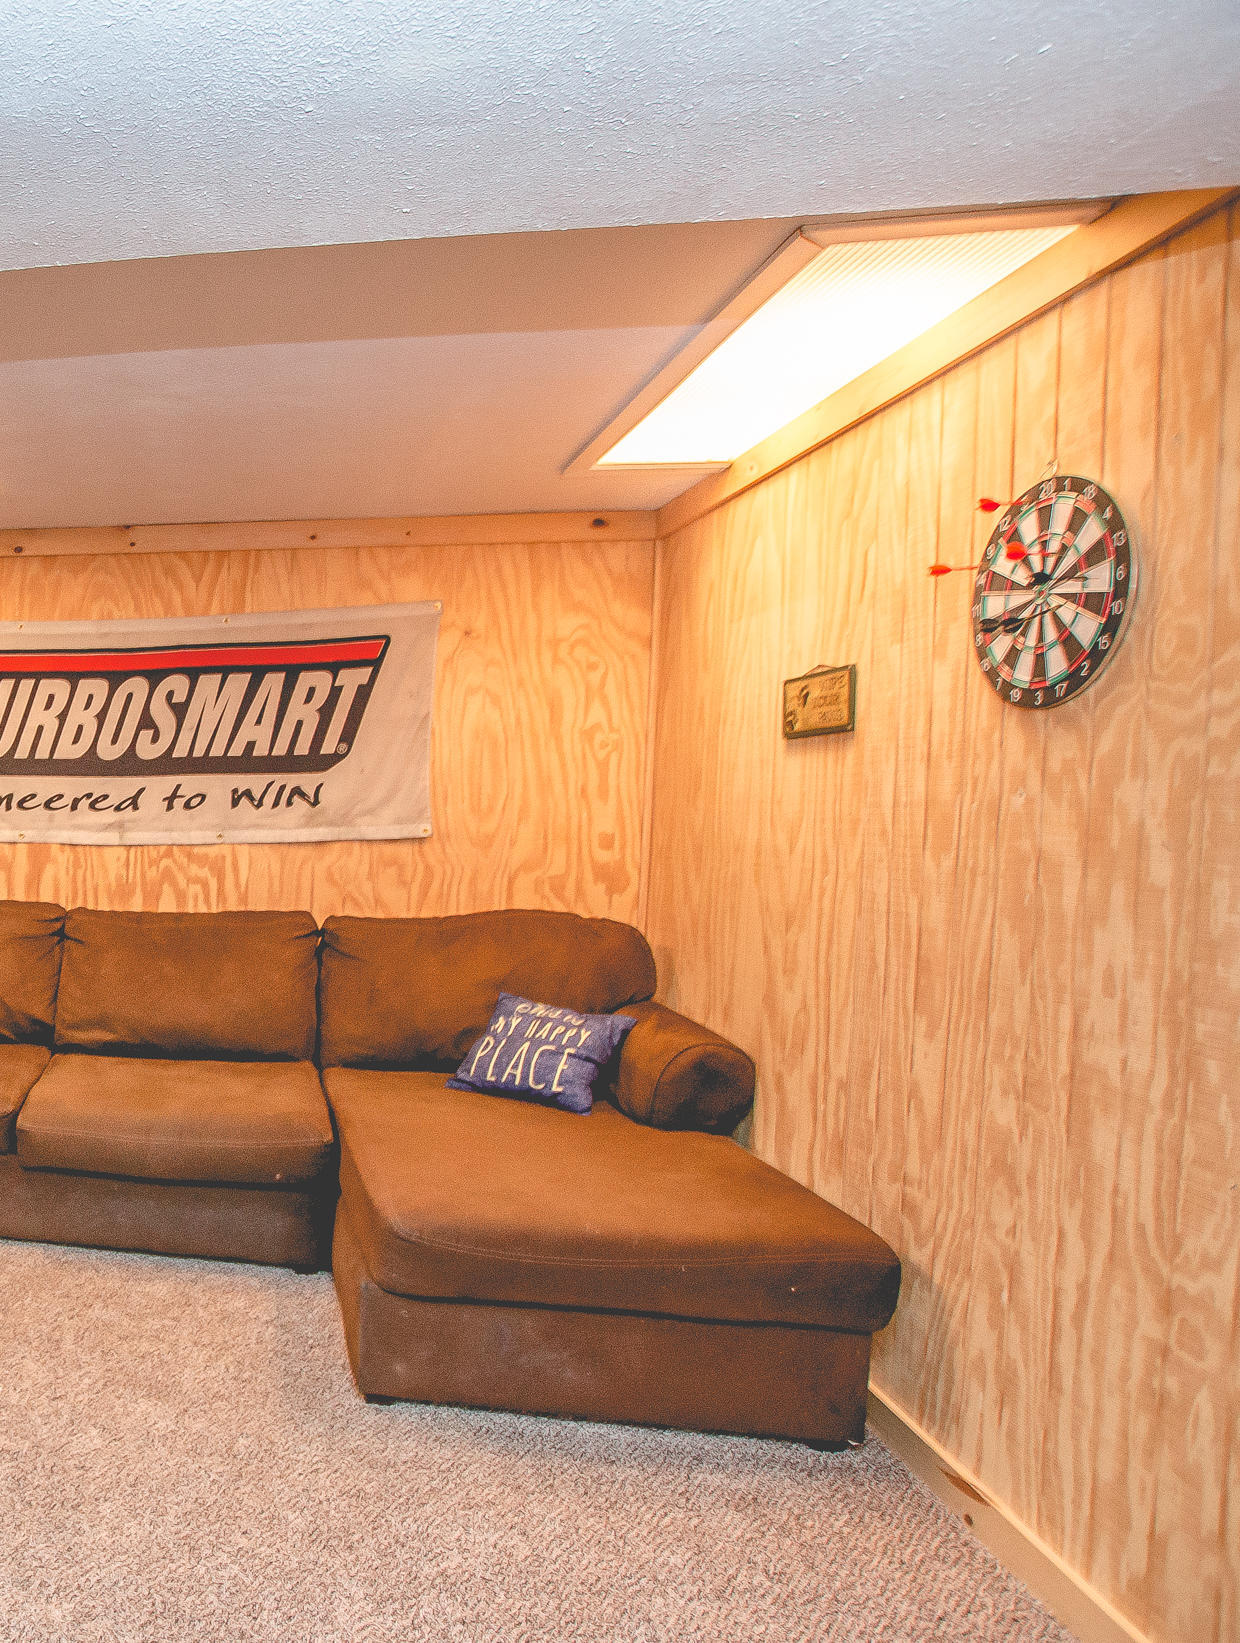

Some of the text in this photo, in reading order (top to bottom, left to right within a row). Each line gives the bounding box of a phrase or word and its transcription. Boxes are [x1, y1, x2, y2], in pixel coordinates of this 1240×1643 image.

[1039, 478, 1057, 499] 20
[1063, 477, 1072, 491] 1
[1083, 482, 1098, 500] 18
[1102, 504, 1113, 521] 4
[998, 514, 1012, 532] 12
[1112, 530, 1127, 547] 13
[986, 543, 996, 560] 9
[1116, 562, 1127, 581] 6
[1110, 599, 1124, 616] 10
[975, 633, 985, 647] 8
[1097, 633, 1111, 650] 15
[1080, 660, 1091, 677] 2
[1010, 688, 1023, 703] 19
[1034, 689, 1044, 706] 3
[1054, 681, 1070, 698] 17
[162, 783, 207, 811] to
[231, 780, 323, 811] WIN
[490, 1016, 592, 1047] MY HAPPY
[469, 1035, 577, 1093] PLACE
